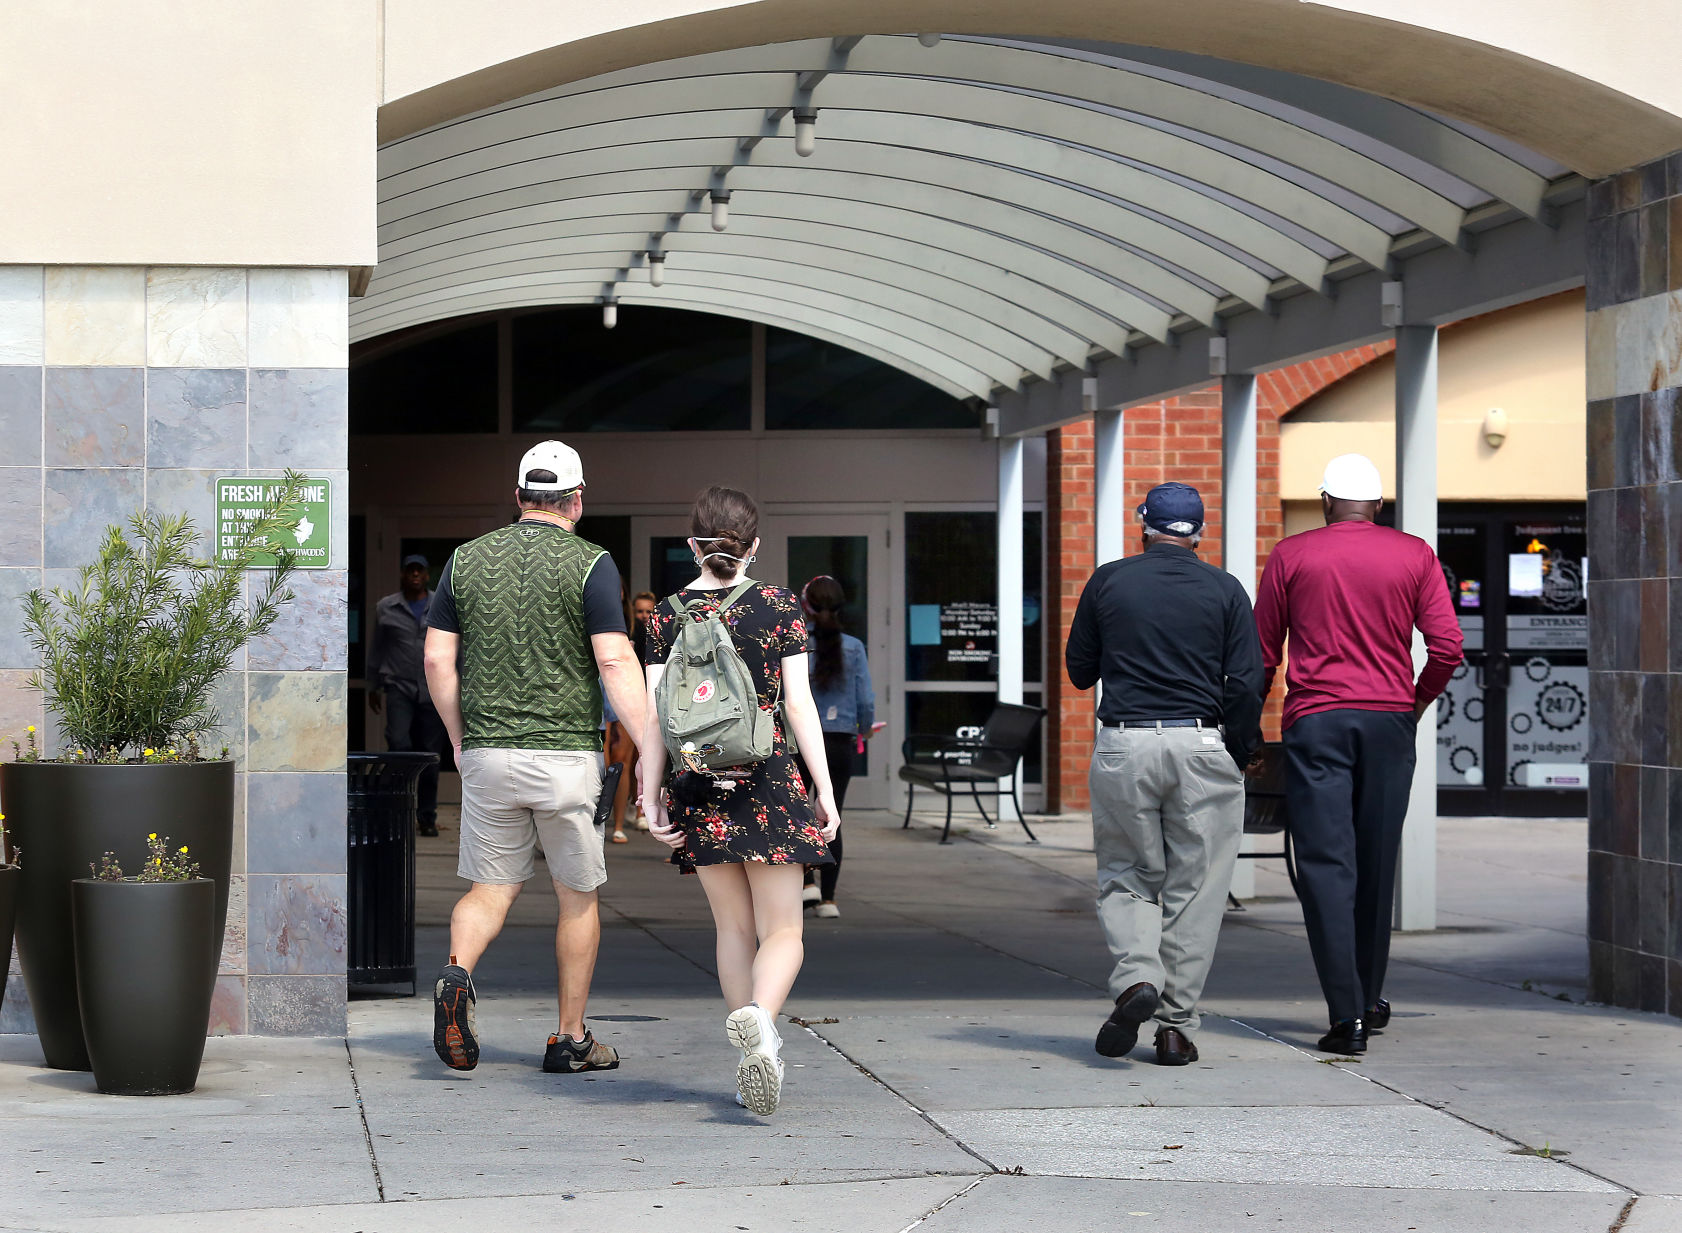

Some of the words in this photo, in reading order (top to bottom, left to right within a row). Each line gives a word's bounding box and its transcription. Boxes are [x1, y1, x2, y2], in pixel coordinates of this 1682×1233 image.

[221, 485, 263, 502] FRESH
[221, 508, 235, 520] NO
[221, 521, 233, 533] AT
[221, 535, 269, 547] ENTNCE
[1530, 617, 1588, 627] ENTRANC
[1545, 697, 1576, 713] 24/7
[1513, 743, 1530, 752] no
[1532, 742, 1582, 754] judges!
